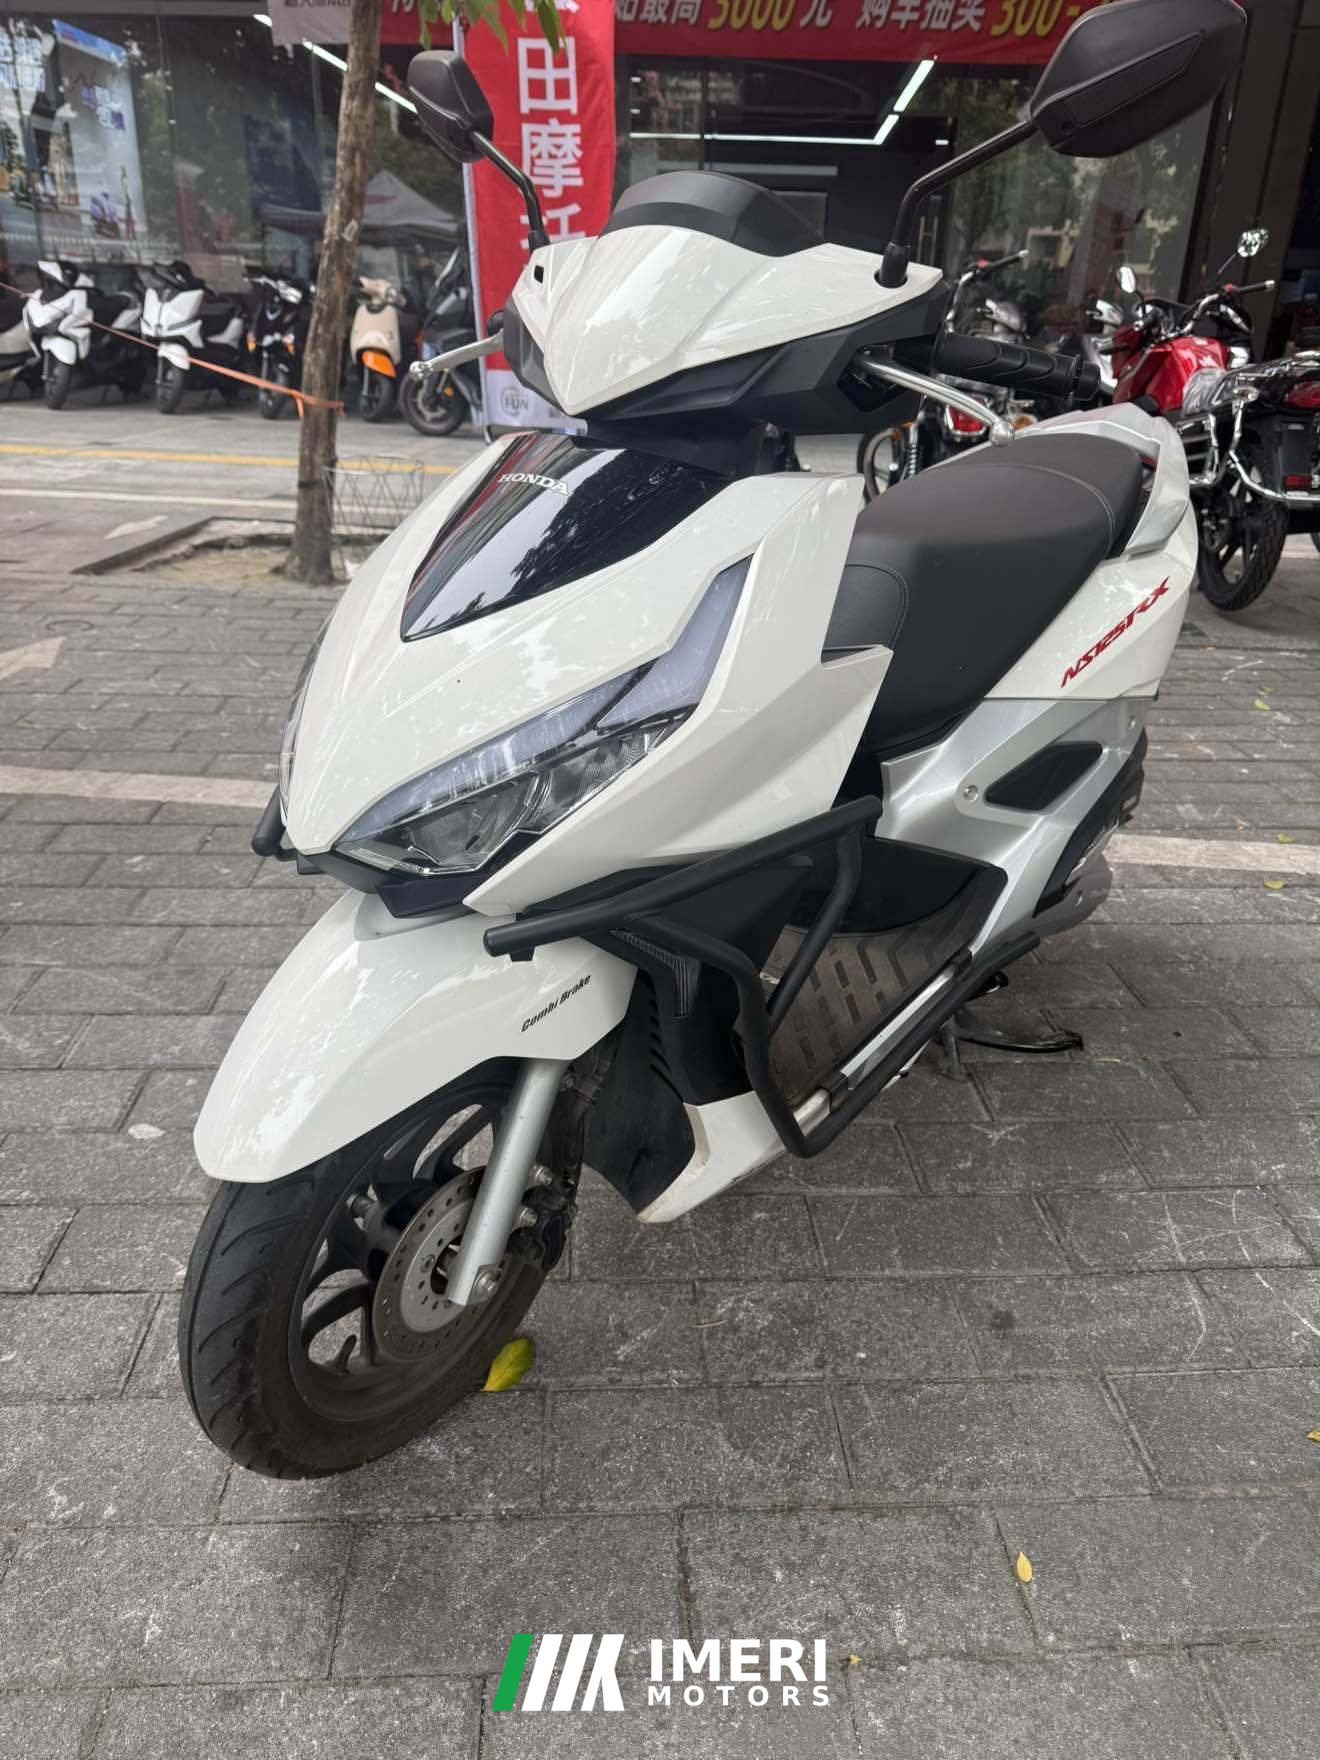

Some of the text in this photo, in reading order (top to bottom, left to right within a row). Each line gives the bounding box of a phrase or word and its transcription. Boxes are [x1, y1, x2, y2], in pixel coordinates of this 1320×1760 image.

[498, 473, 569, 496] HONDA
[1061, 575, 1170, 688] NS125RX
[521, 974, 591, 1032] Combi Brake
